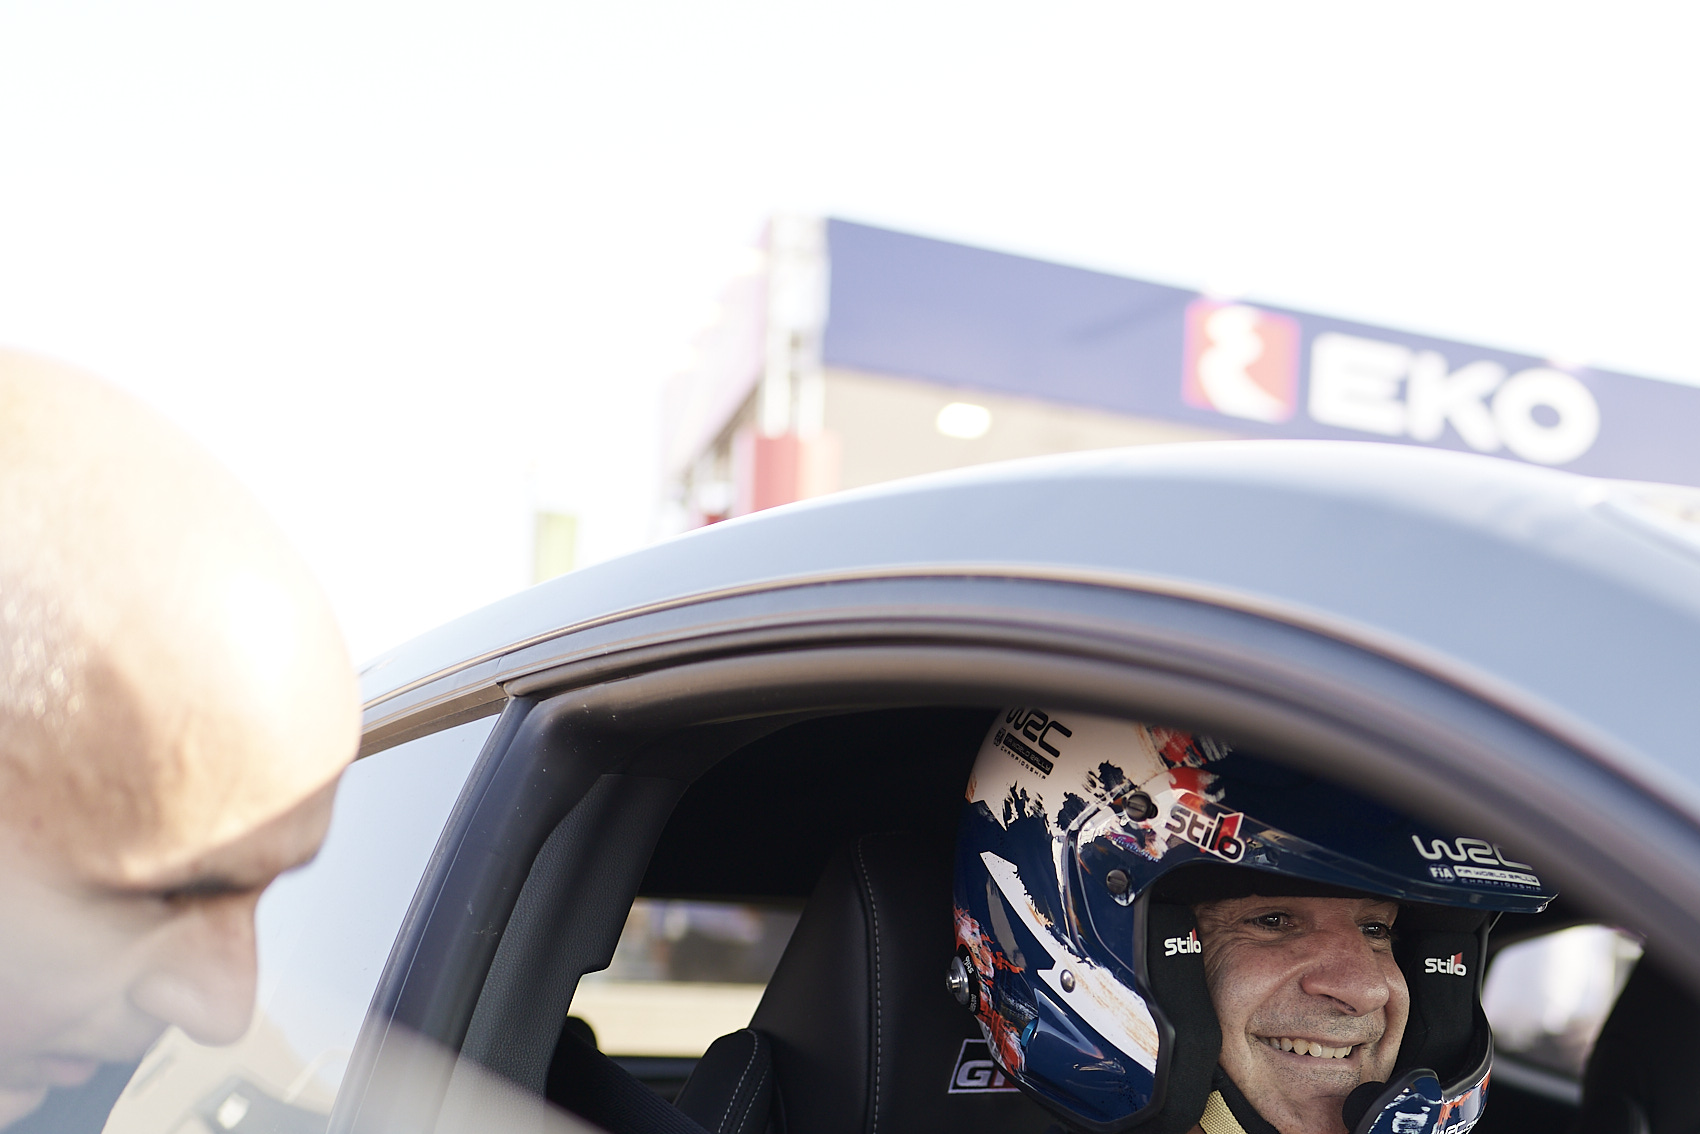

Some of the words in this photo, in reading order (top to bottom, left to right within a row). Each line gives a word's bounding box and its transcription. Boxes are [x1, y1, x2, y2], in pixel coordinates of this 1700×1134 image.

[1307, 330, 1601, 465] EKO
[1005, 706, 1073, 758] WRC
[1164, 804, 1243, 861] Stilo
[1411, 834, 1533, 871] WRC
[1430, 866, 1454, 880] FIA
[1461, 877, 1542, 891] CHAMPIONSHIP
[1164, 929, 1202, 957] Stilo
[1424, 953, 1467, 977] Stilo
